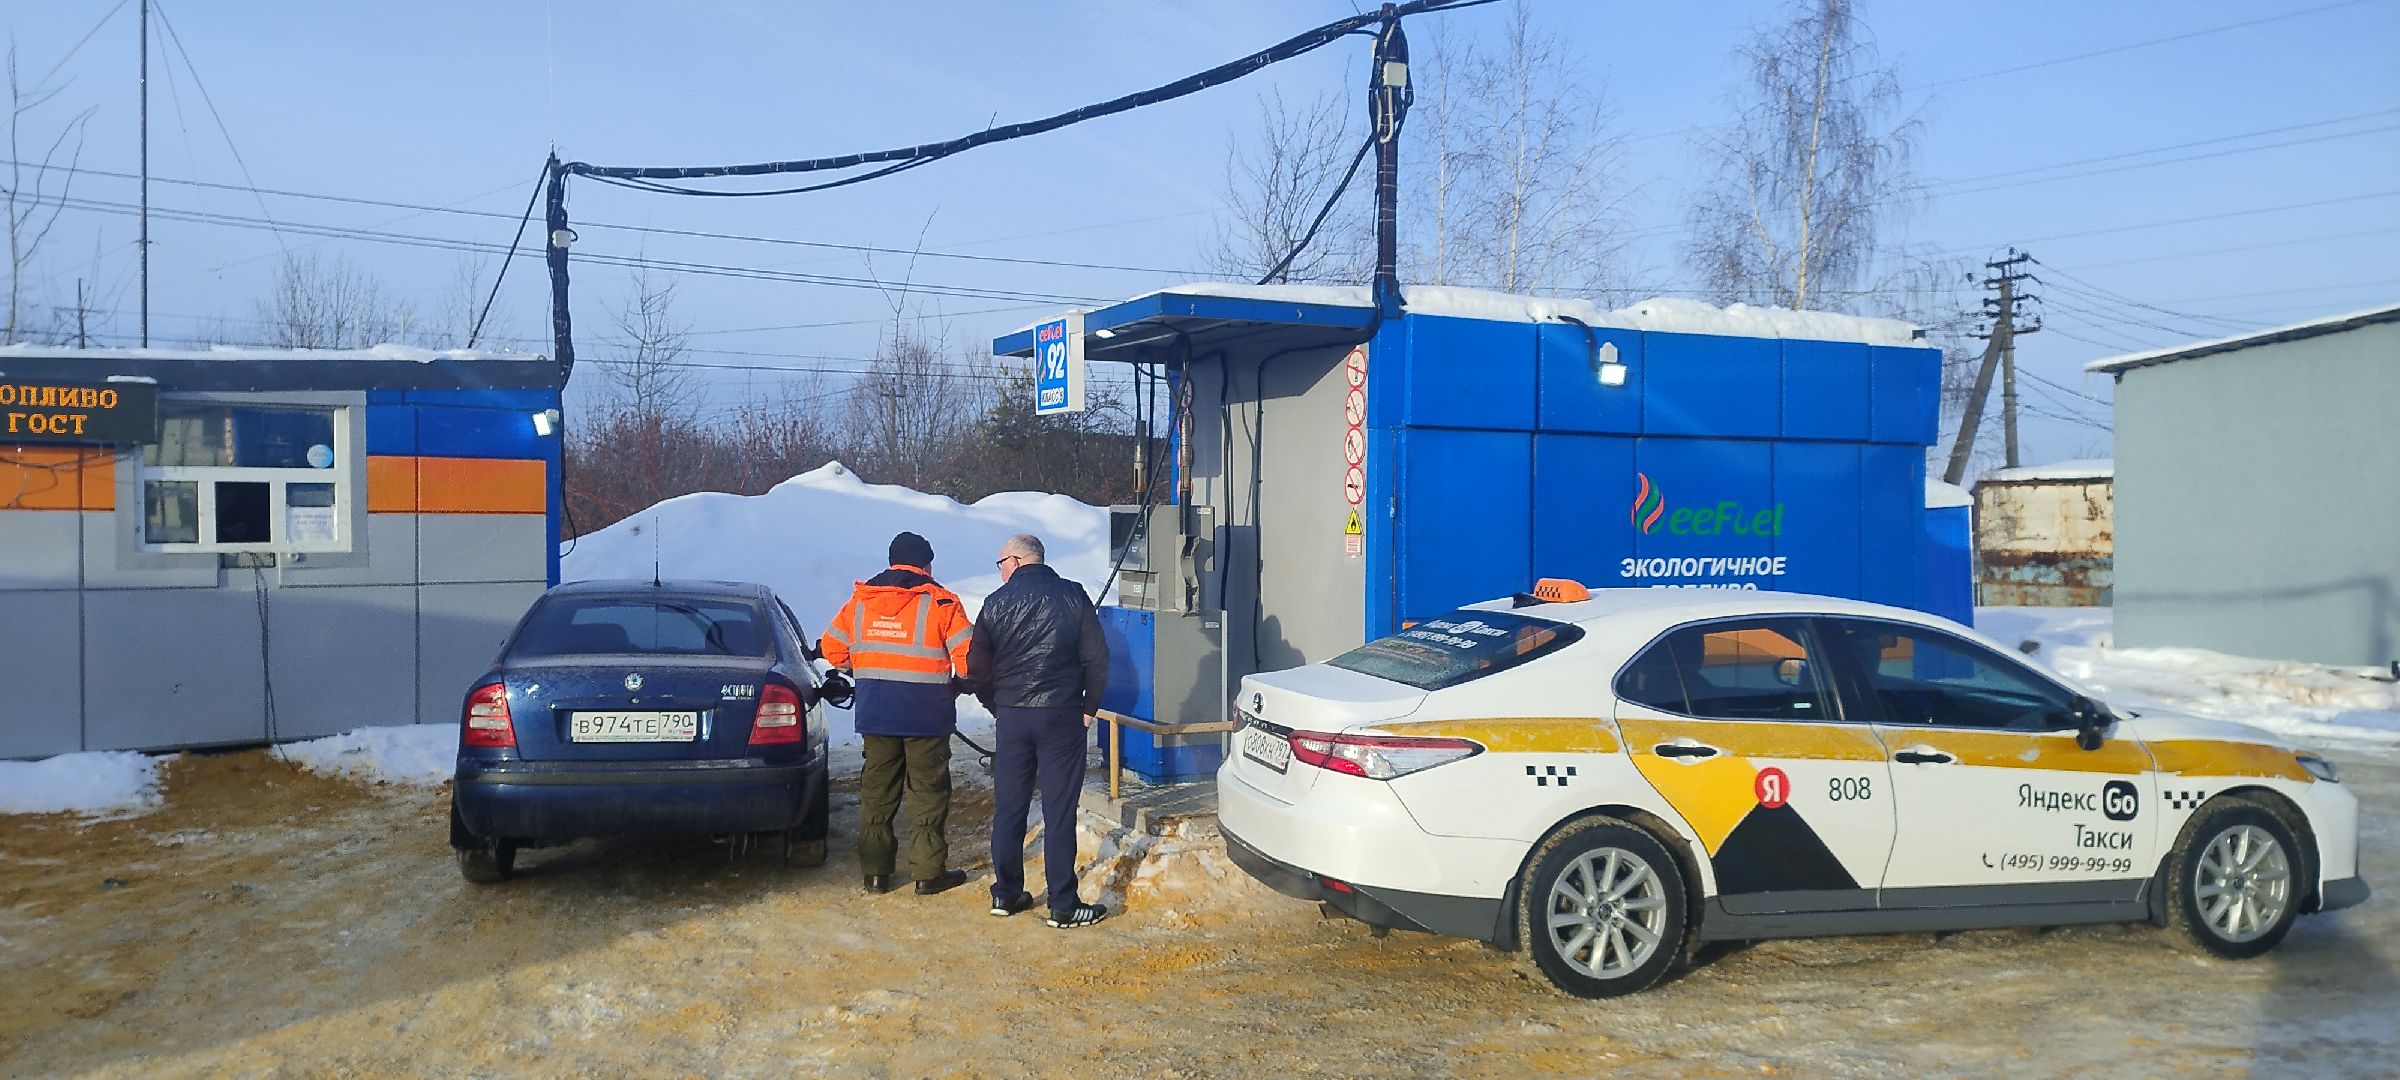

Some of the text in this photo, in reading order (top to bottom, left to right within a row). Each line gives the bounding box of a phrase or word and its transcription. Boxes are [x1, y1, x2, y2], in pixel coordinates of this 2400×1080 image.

[1047, 342, 1065, 380] 92
[8, 412, 88, 435] ГОСТ
[1620, 556, 1787, 578] ЭКОЛОГИЧНОЕ
[579, 714, 691, 734] В974ТЕ 790
[1763, 774, 1781, 803] Я
[1829, 777, 1871, 801] 808
[2018, 783, 2136, 815] Яндекс Go
[2073, 823, 2133, 850] Такси
[2001, 852, 2132, 873] (495) 999-99-99
